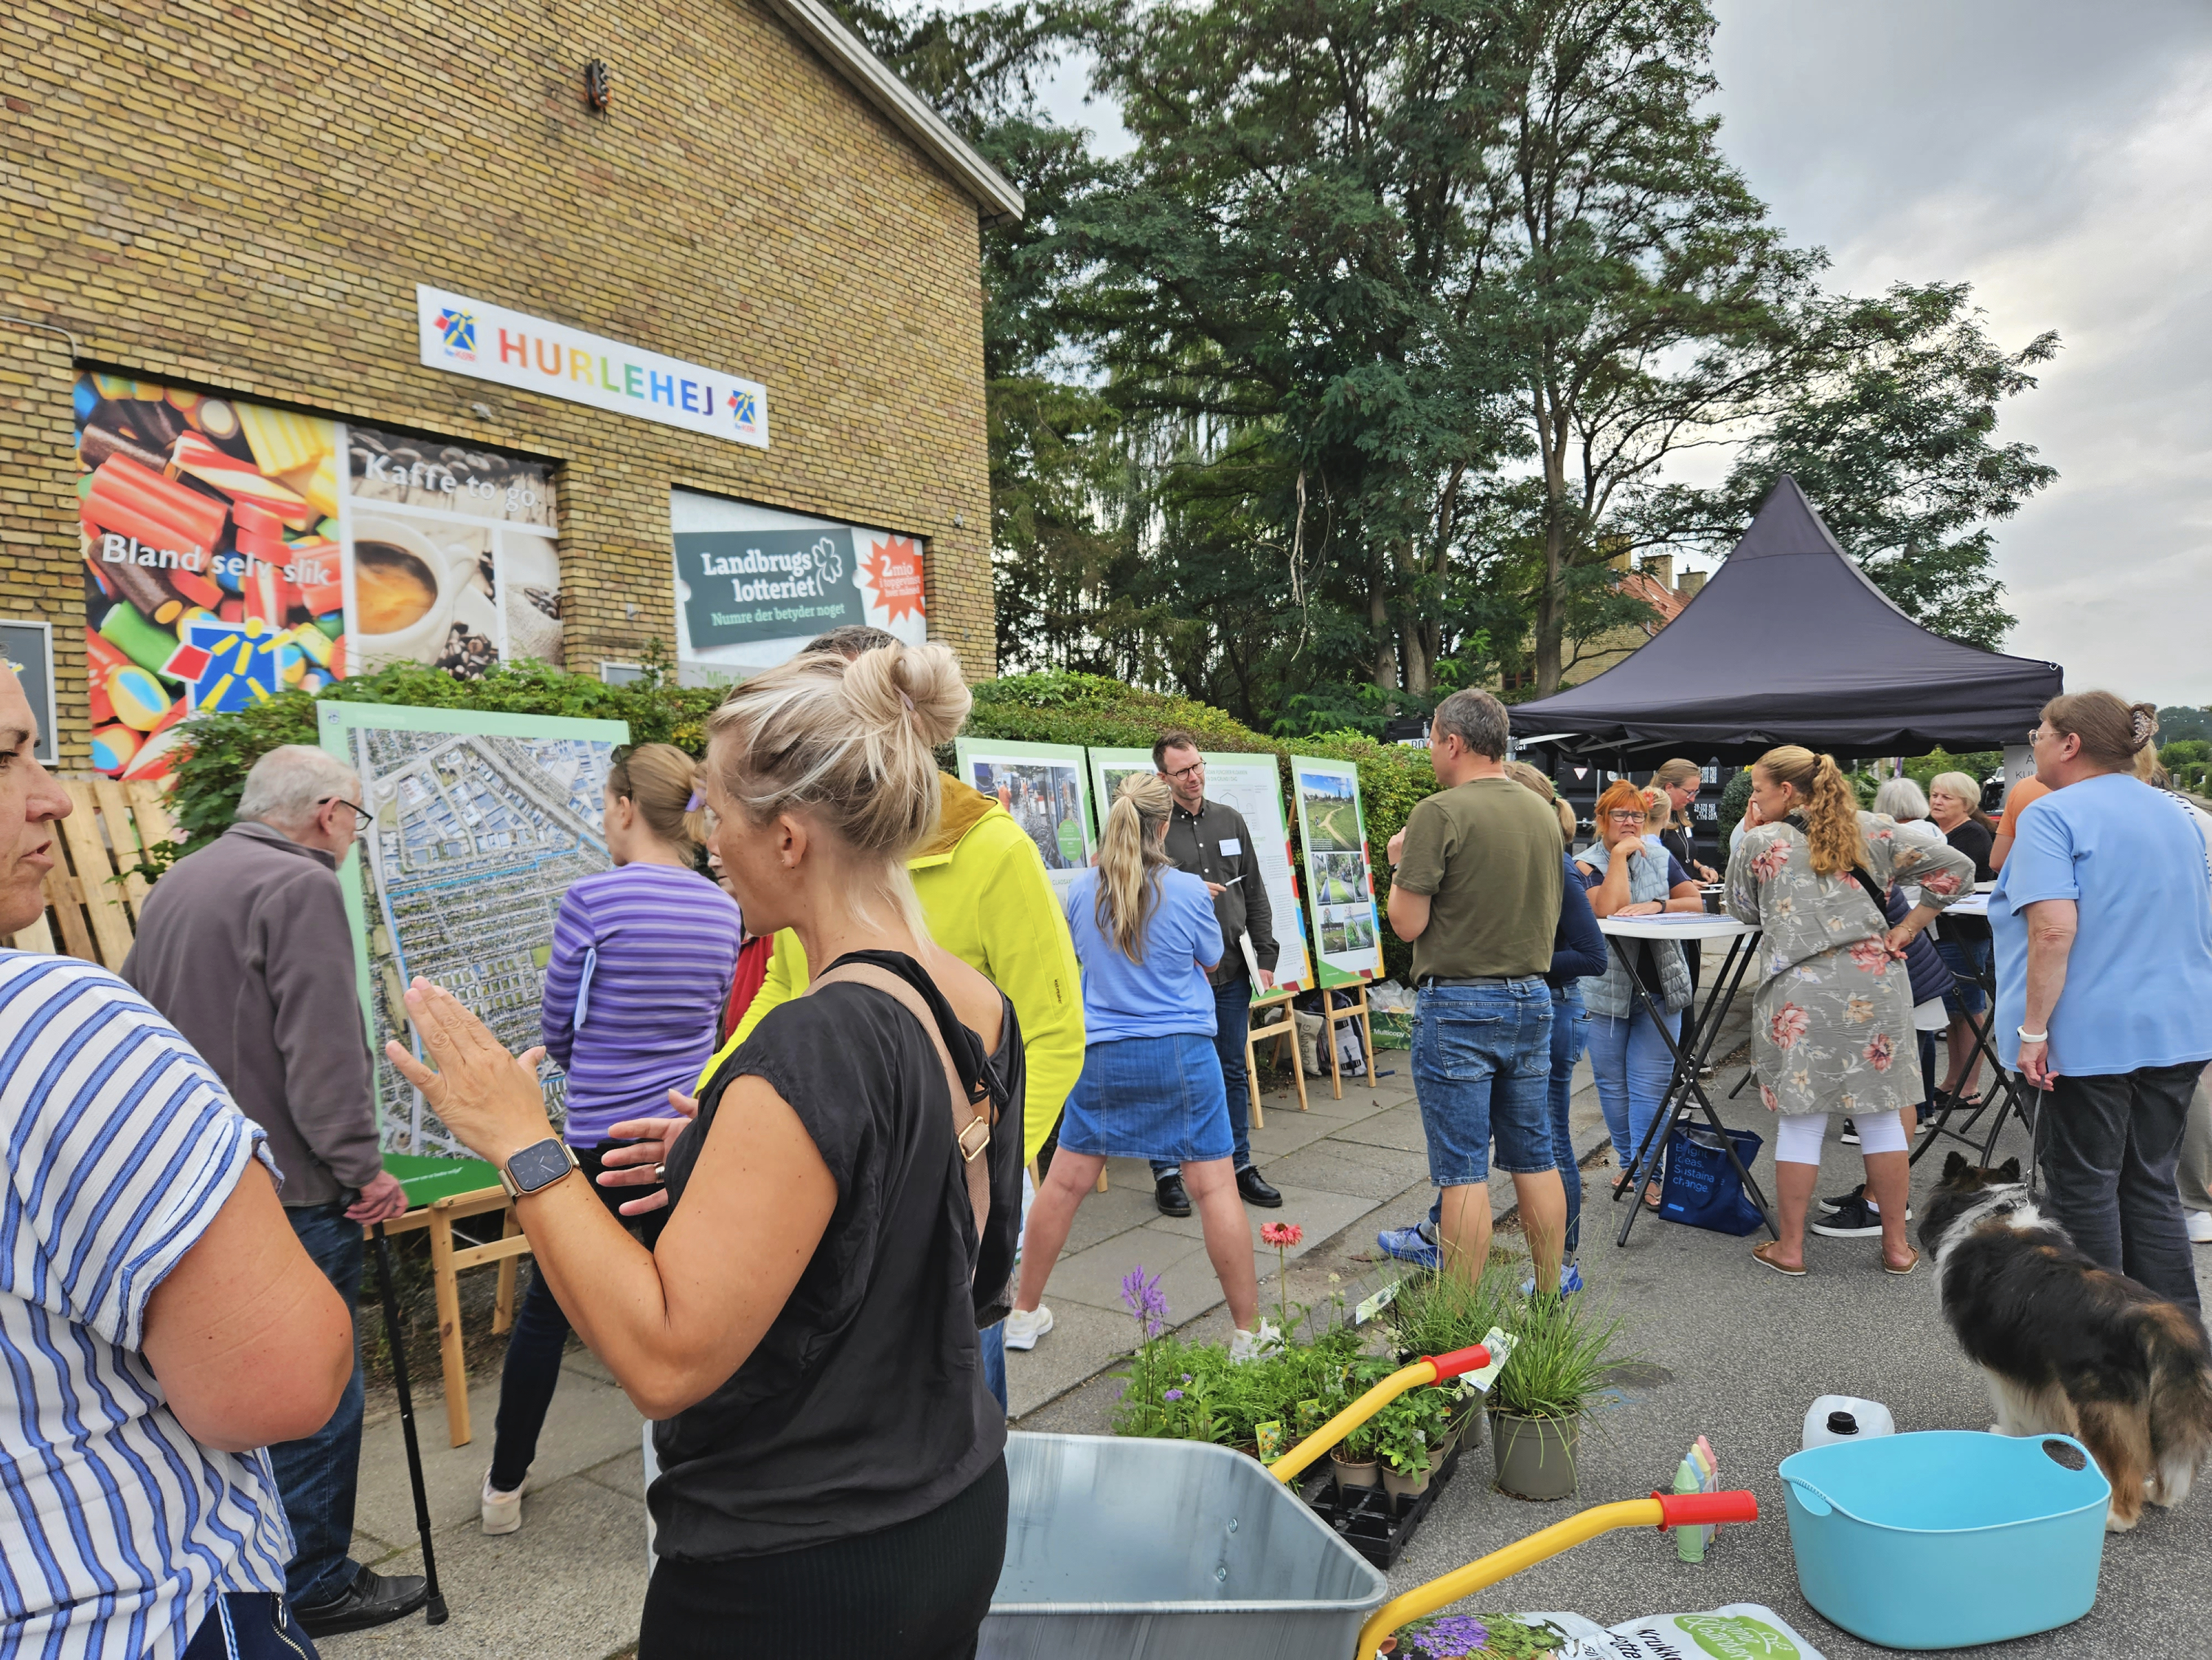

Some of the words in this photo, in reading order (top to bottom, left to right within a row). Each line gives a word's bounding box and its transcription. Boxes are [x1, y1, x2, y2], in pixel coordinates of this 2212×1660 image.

[498, 327, 714, 417] HURLEHEJ
[365, 451, 458, 494] Kaffe
[466, 474, 495, 501] to
[505, 486, 537, 513] go
[102, 532, 201, 573] Bland
[211, 551, 274, 579] selv
[283, 558, 332, 586] slik
[700, 548, 812, 577] Landbrugs
[731, 575, 816, 602] lotteriet
[711, 611, 753, 627] Numre
[754, 608, 773, 623] der
[774, 605, 815, 625] betyder
[817, 602, 845, 619] noget
[1301, 1024, 1312, 1066] OPENING
[1373, 1028, 1405, 1038] Multicopy
[1676, 1142, 1708, 1159] Bight
